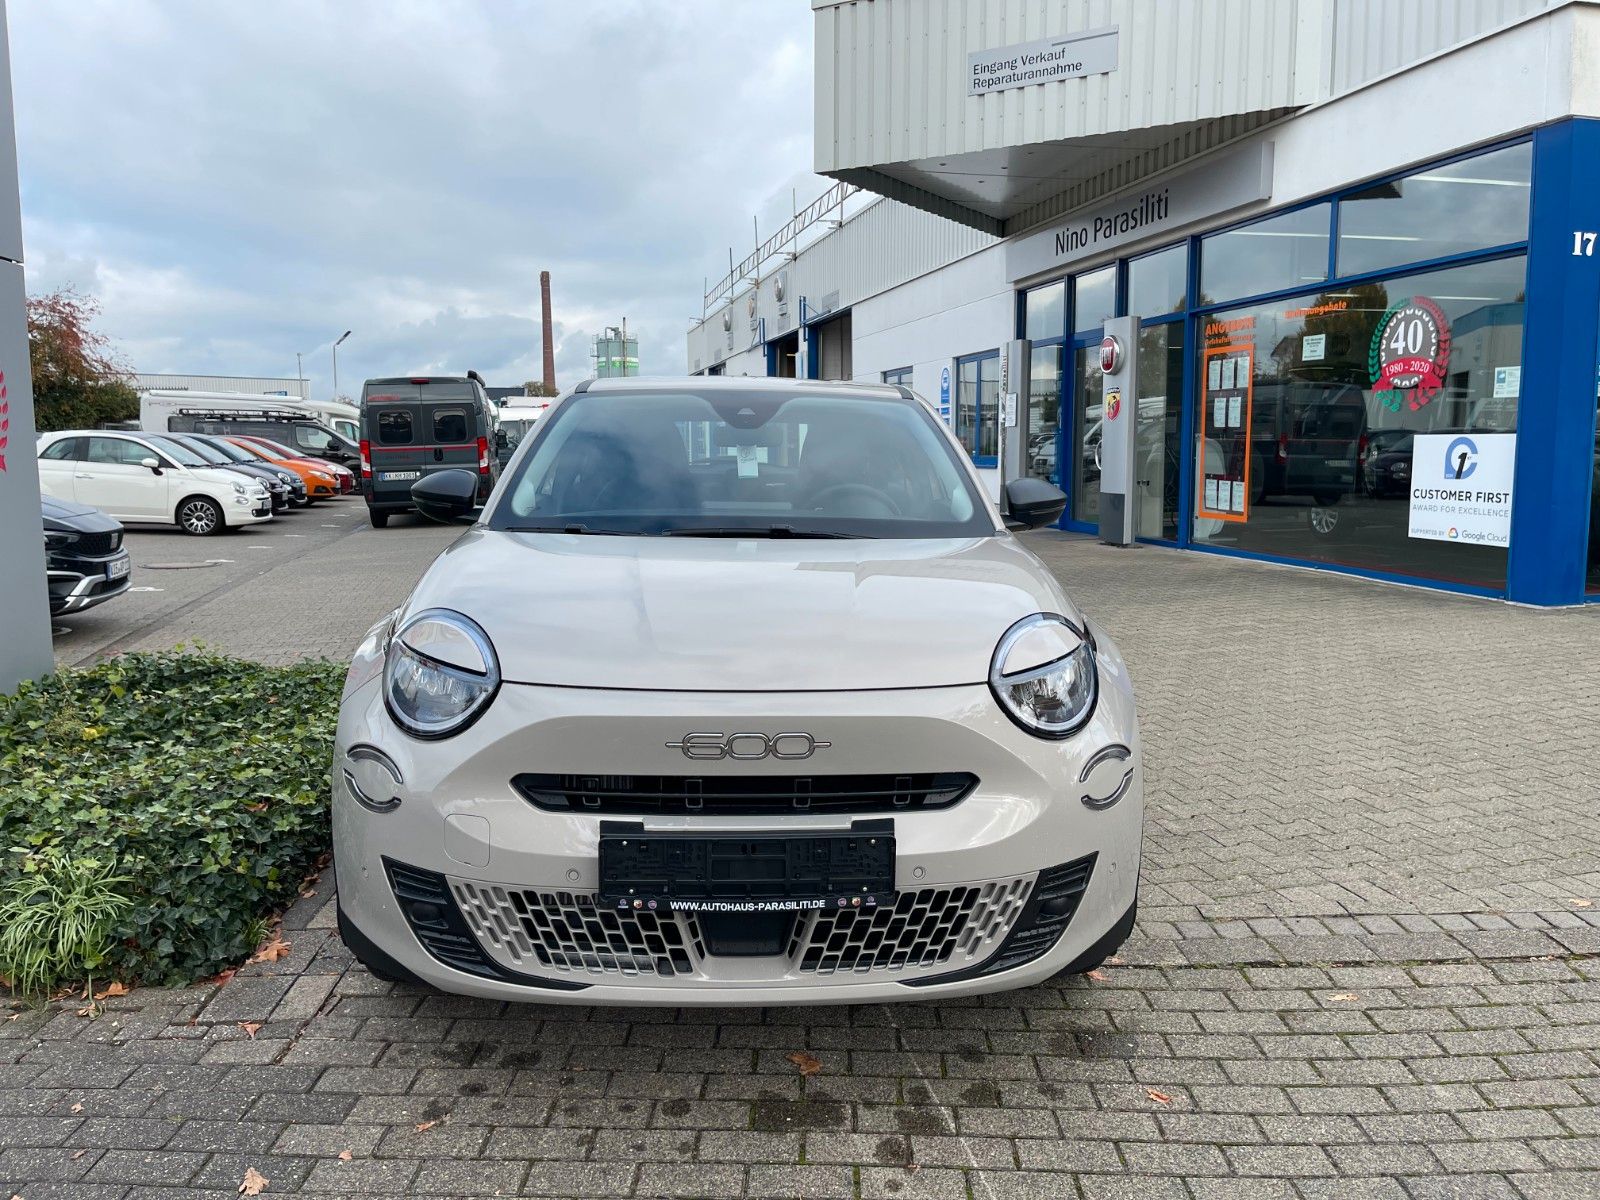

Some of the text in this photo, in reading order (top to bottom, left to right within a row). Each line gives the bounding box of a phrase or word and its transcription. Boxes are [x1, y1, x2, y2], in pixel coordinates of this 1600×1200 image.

[973, 47, 1066, 75] Eingang Verkauf
[973, 62, 1083, 89] Reparaturannahme
[1055, 188, 1169, 256] Nino Parasiliti
[1572, 231, 1598, 257] 17
[1390, 319, 1424, 355] 40
[1385, 362, 1404, 376] 1980
[1409, 360, 1430, 373] 2020
[1413, 488, 1510, 504] CUSTOMER FIRST
[1412, 504, 1510, 518] AWARD FOR EXCELLENCE
[1461, 530, 1486, 542] Google
[1486, 532, 1507, 543] Cloud
[681, 731, 816, 761] 600
[670, 899, 826, 911] WWW.AUTOHAUS-PARASILITI.DE
